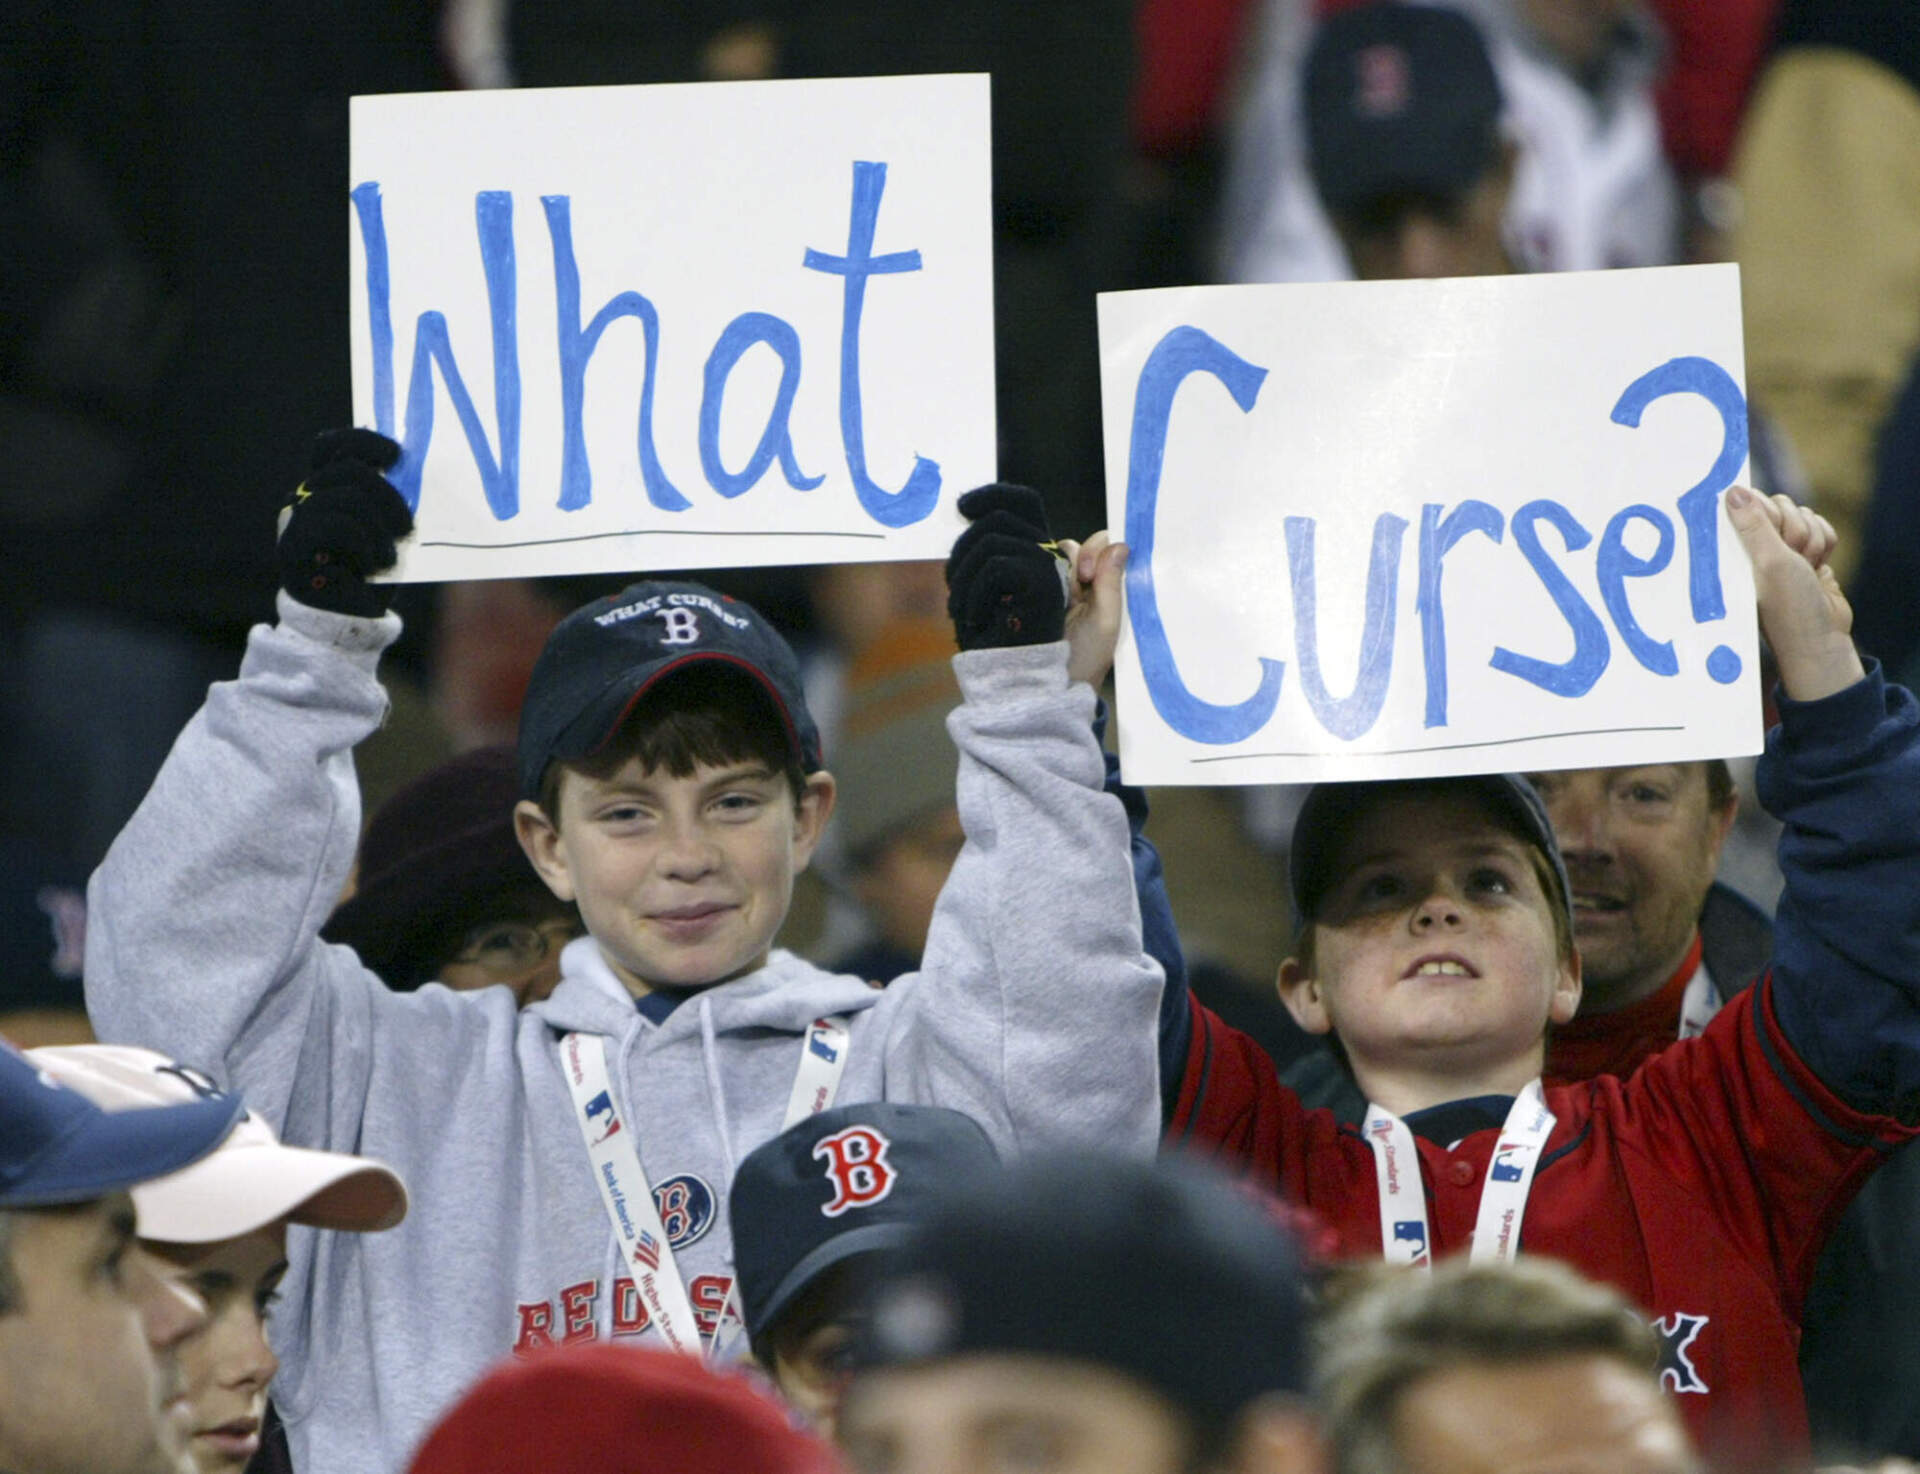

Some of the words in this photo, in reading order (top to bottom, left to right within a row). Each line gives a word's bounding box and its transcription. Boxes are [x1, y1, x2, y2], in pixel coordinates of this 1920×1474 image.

[351, 160, 943, 529] What
[1125, 324, 1749, 745] Curse?
[594, 595, 662, 627] WHAT
[654, 607, 700, 645] B
[601, 1161, 619, 1188] Bank
[614, 1198, 635, 1240] America
[812, 1125, 898, 1218] B
[640, 1273, 664, 1313] Higher
